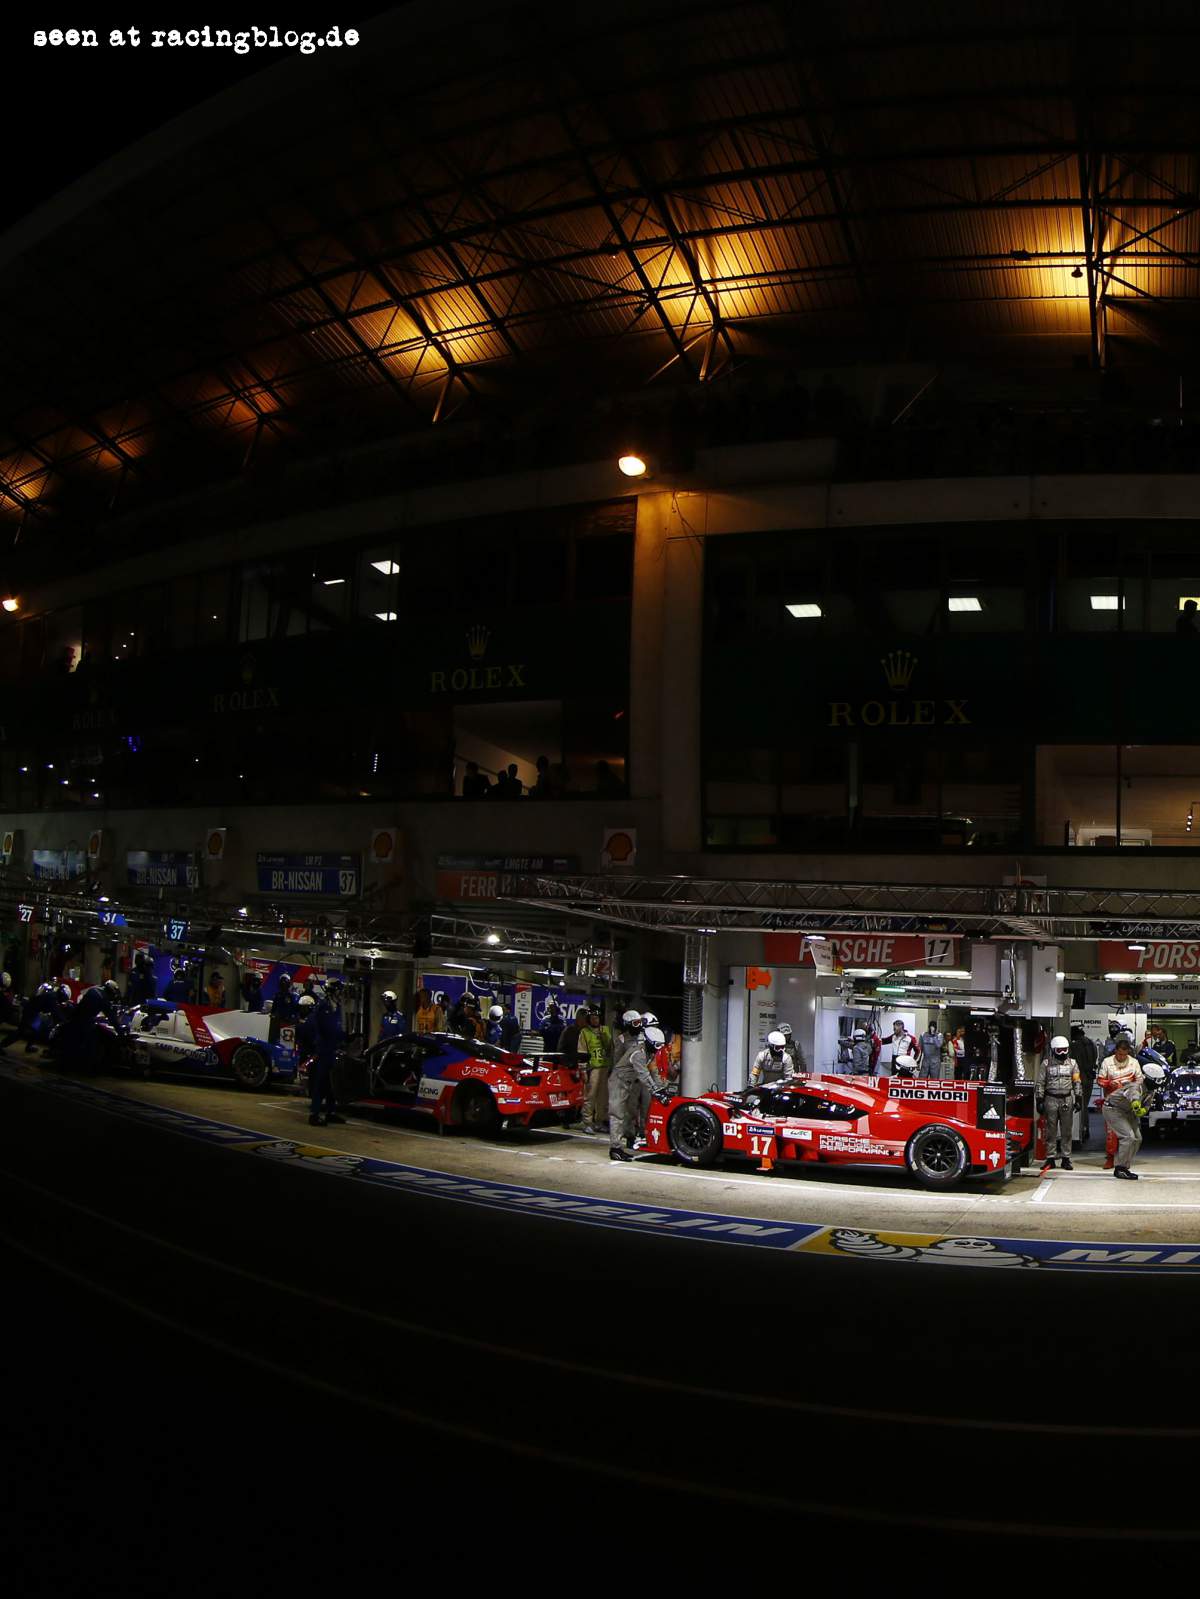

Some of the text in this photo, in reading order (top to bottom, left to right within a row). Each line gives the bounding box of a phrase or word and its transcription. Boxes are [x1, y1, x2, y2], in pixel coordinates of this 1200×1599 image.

[430, 664, 528, 693] ROLEX
[211, 688, 280, 712] ROLEX
[825, 699, 976, 727] ROLEX
[271, 869, 355, 893] BR-NISSAN 37
[20, 908, 33, 923] 27
[170, 925, 184, 940] 37
[799, 937, 897, 964] PSCHE
[926, 939, 951, 964] 17
[885, 978, 932, 986] Porsche Team
[1150, 983, 1199, 991] Porsche Team
[868, 1076, 880, 1088] HY
[888, 1078, 979, 1090] PORSCHE
[889, 1088, 968, 1101] DMG MORI
[725, 1124, 735, 1133] P1
[751, 1136, 772, 1155] 17
[820, 1135, 870, 1144] PORSCHE
[371, 1171, 796, 1238] MICHELIN
